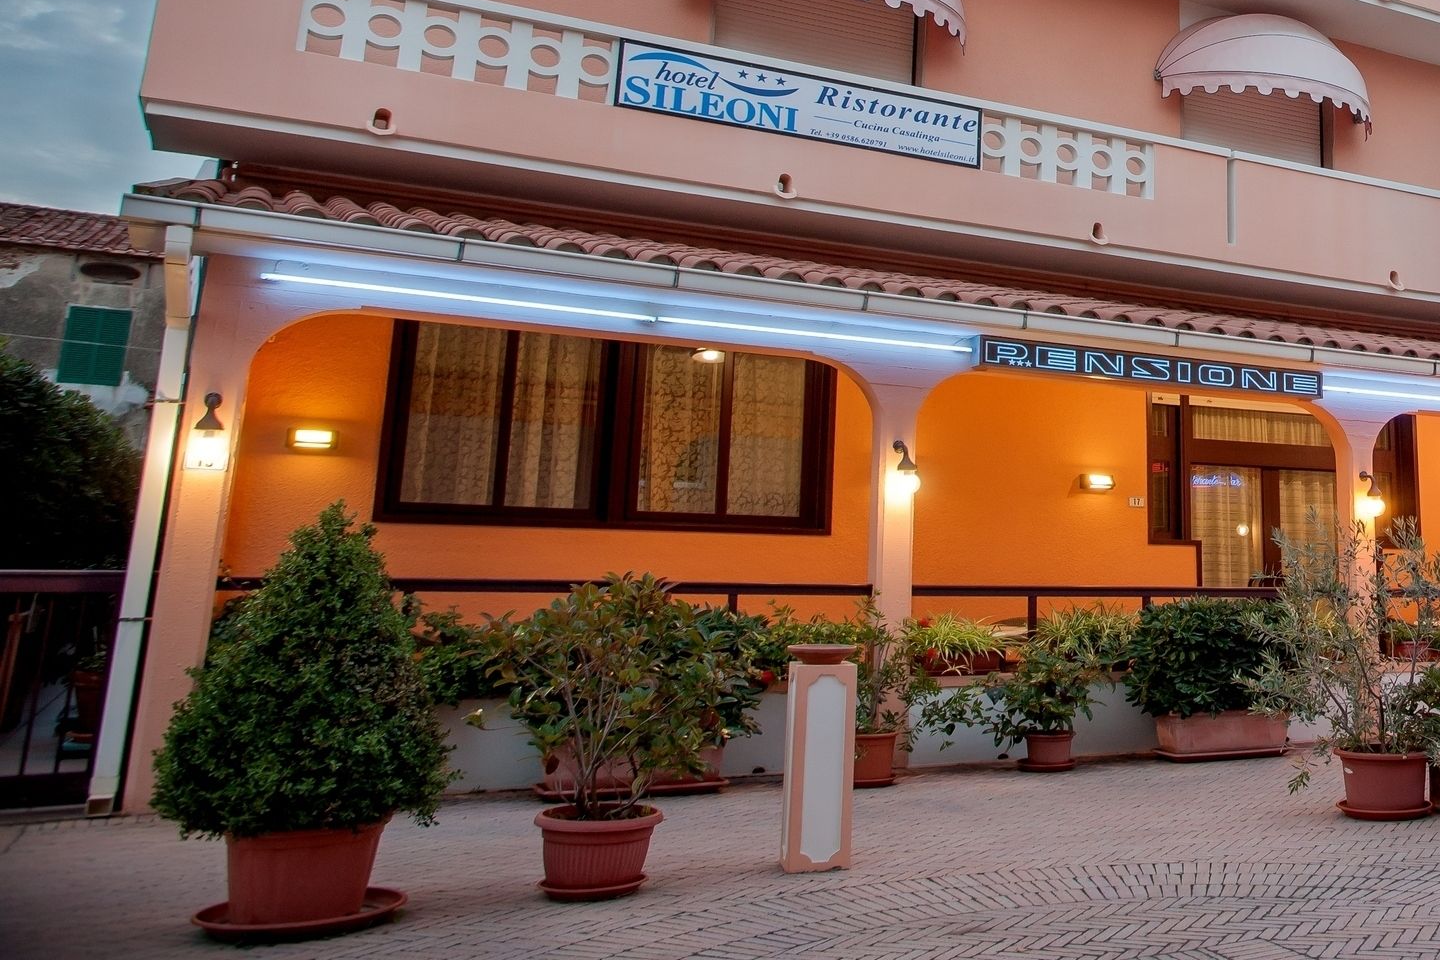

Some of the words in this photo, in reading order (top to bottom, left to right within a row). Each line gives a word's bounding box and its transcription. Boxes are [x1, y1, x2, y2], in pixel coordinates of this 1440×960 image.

[655, 61, 720, 90] hotel
[623, 75, 800, 133] SILEONI
[815, 85, 978, 133] Ristorante
[809, 128, 823, 137] Tel.
[826, 131, 840, 139] +39
[897, 143, 975, 163] www.hotelsileoni.it
[853, 119, 890, 133] Cucina
[892, 125, 941, 143] Casalinga
[985, 340, 1318, 396] PENSIONE
